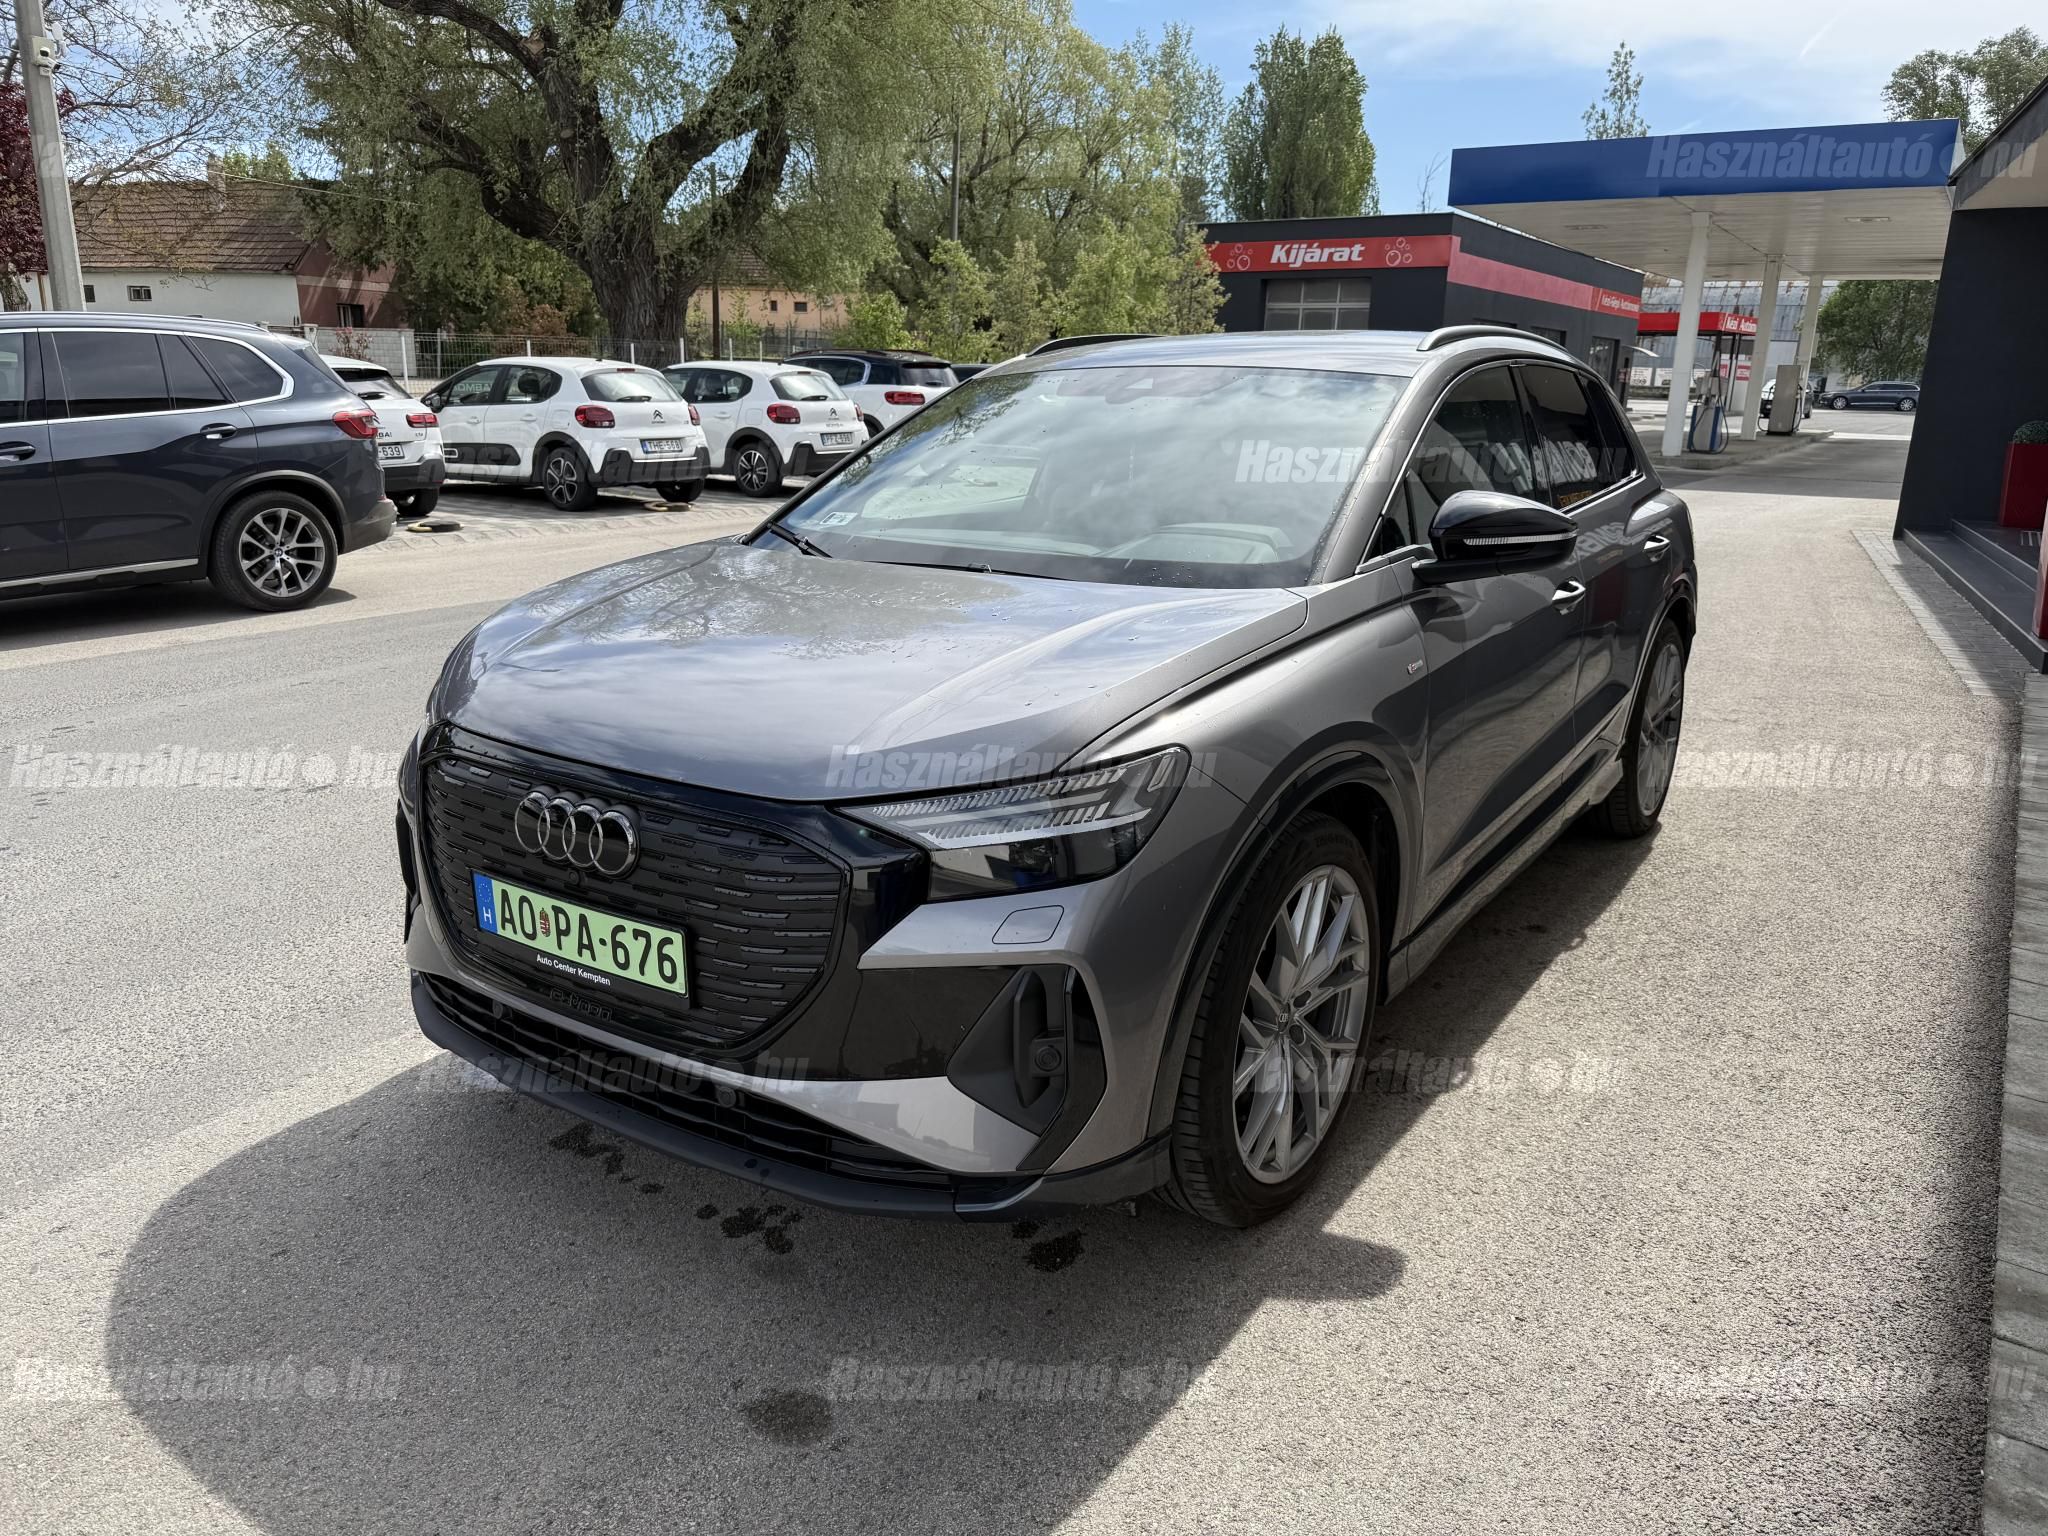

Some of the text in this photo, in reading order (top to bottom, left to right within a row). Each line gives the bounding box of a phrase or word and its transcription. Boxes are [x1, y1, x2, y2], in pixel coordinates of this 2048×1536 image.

[1270, 242, 1365, 268] Kijárat
[378, 446, 401, 457] -639
[536, 954, 611, 986] Auto Center Kempten
